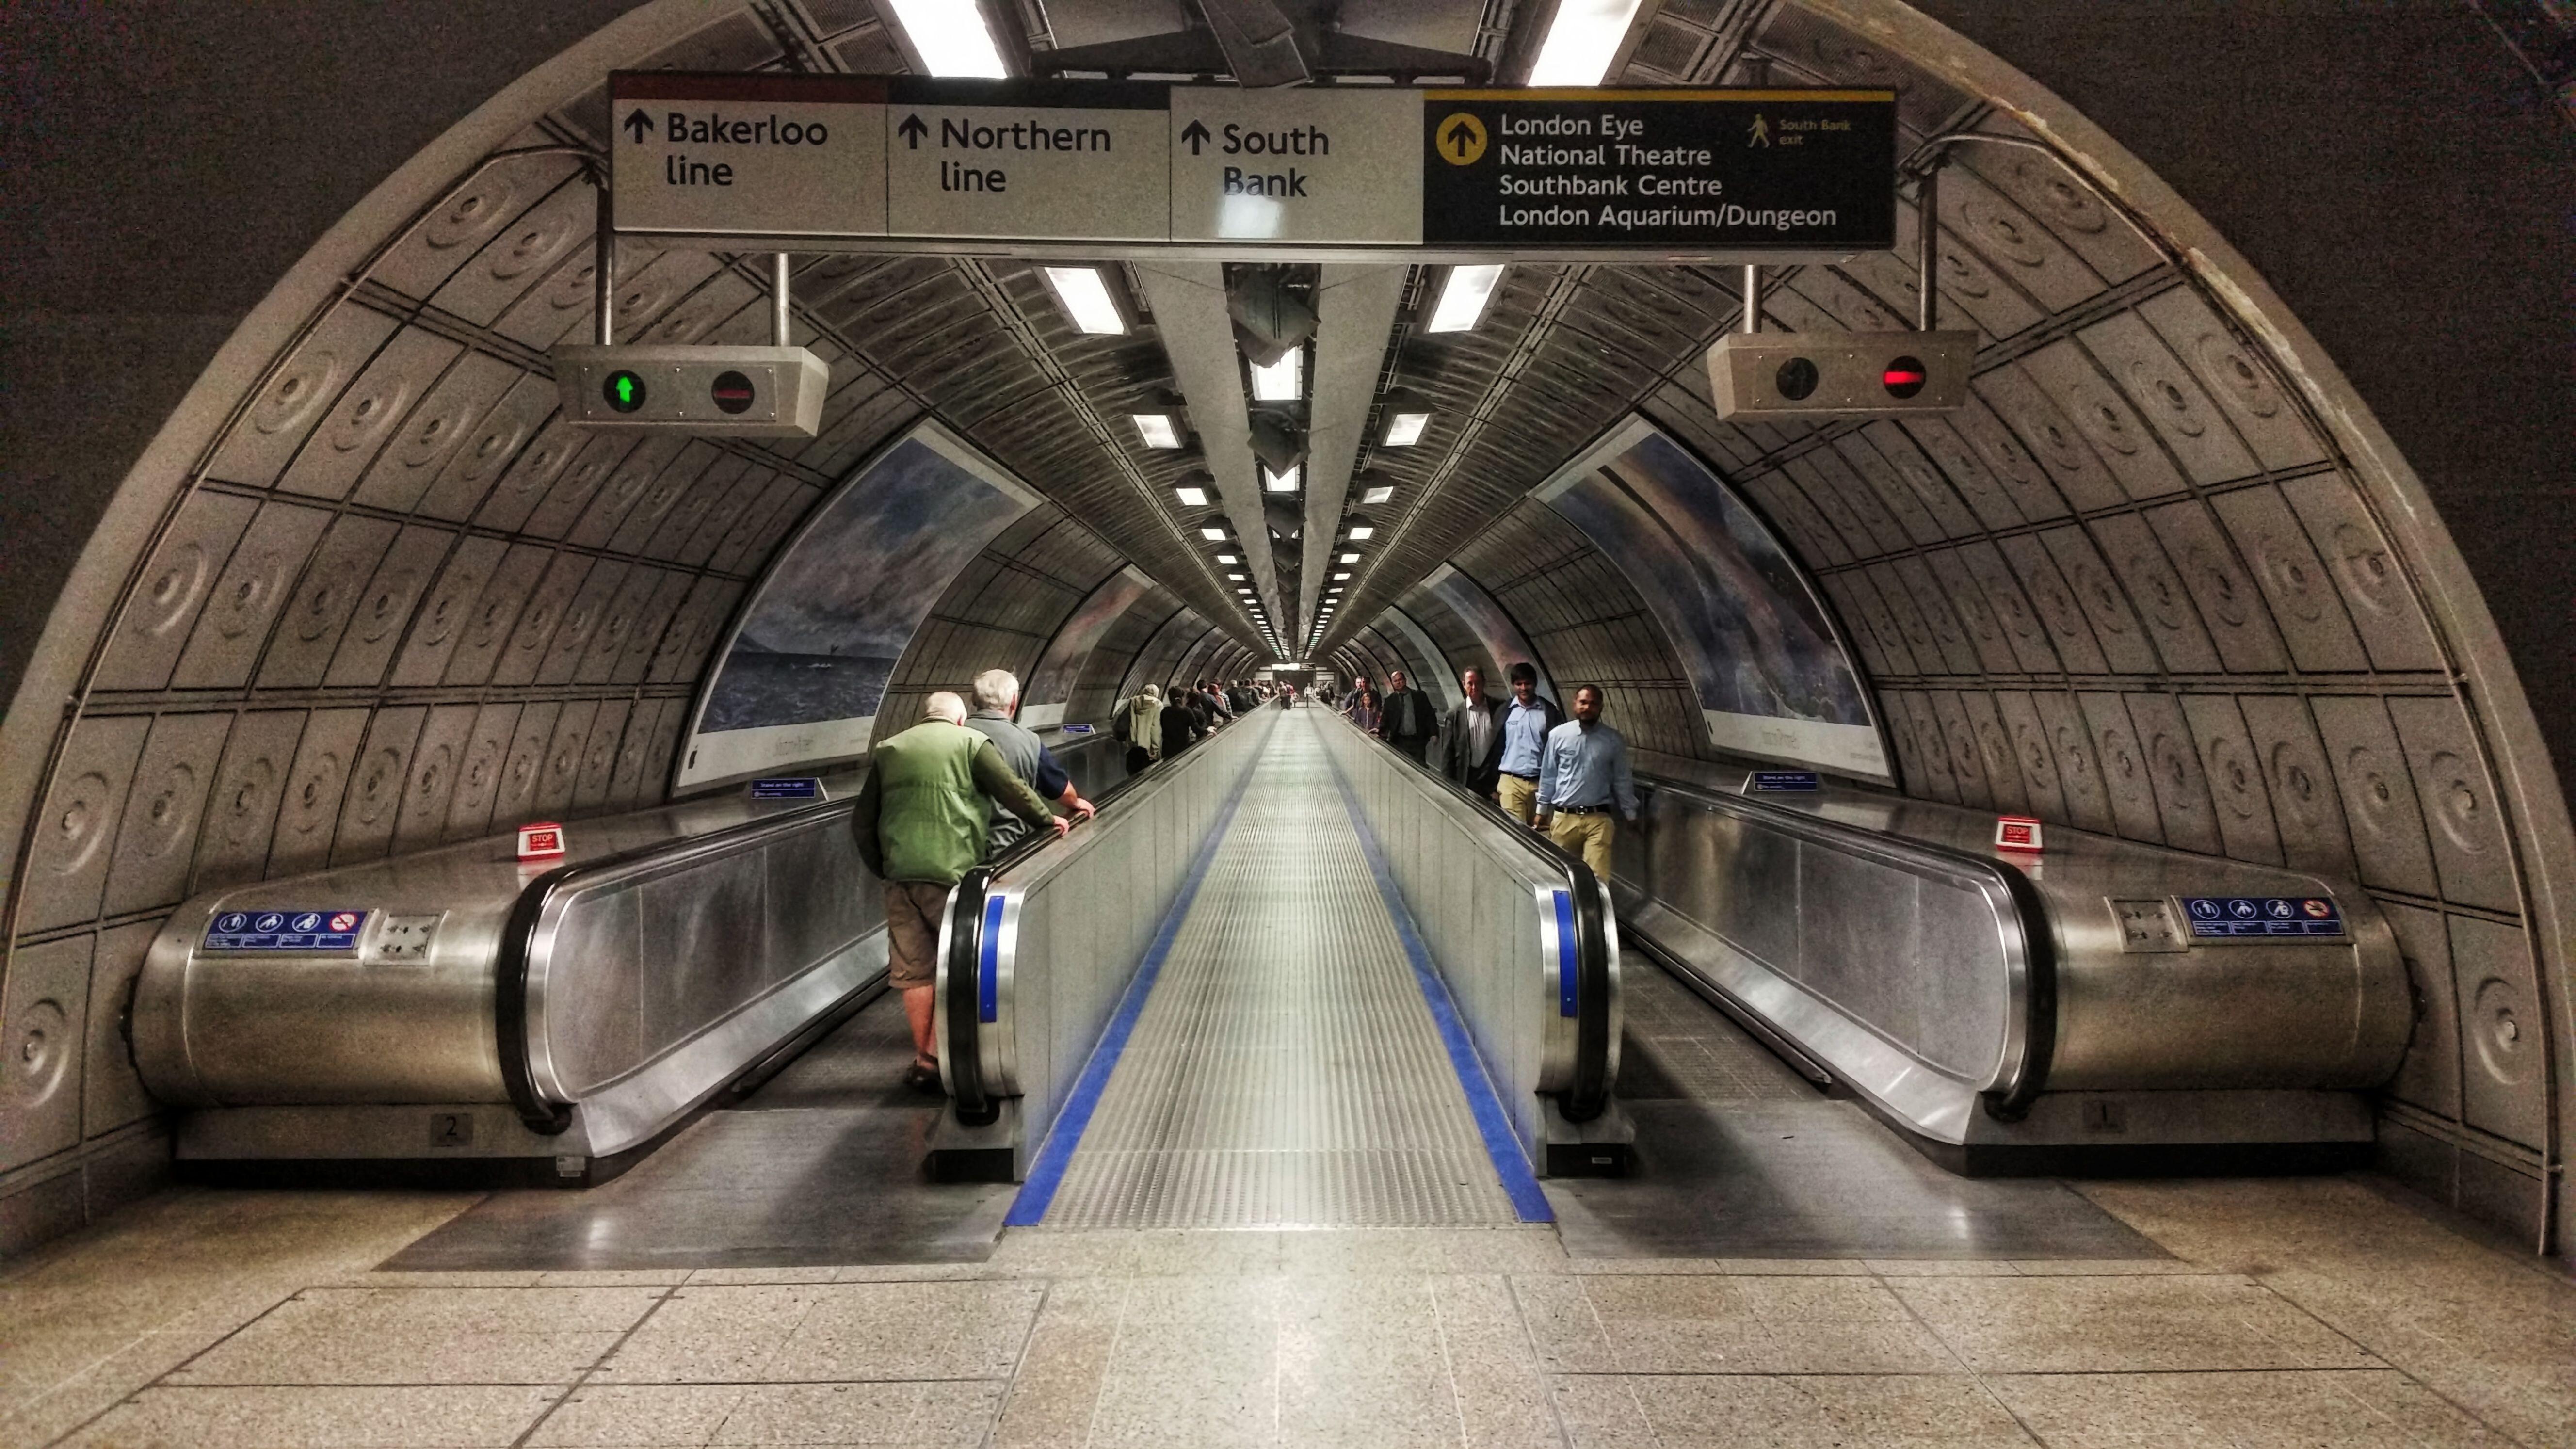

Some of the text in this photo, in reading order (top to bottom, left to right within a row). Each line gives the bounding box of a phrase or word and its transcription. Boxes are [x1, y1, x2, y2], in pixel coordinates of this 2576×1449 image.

[667, 112, 829, 146] Bakerloo
[941, 118, 1111, 152] Northern
[1222, 123, 1329, 155] South
[1501, 113, 1644, 141] London Eye
[1779, 119, 1852, 131] South Bank
[1779, 135, 1803, 145] exit
[1500, 144, 1712, 166] National Theatre
[666, 154, 734, 187] line
[940, 161, 1007, 193] line
[1224, 166, 1308, 197] Bank
[1499, 174, 1723, 196] Southbank Centre
[1499, 203, 1837, 231] London Aquarium/Dungeon
[532, 834, 553, 842] STOP
[446, 1116, 457, 1136] 2
